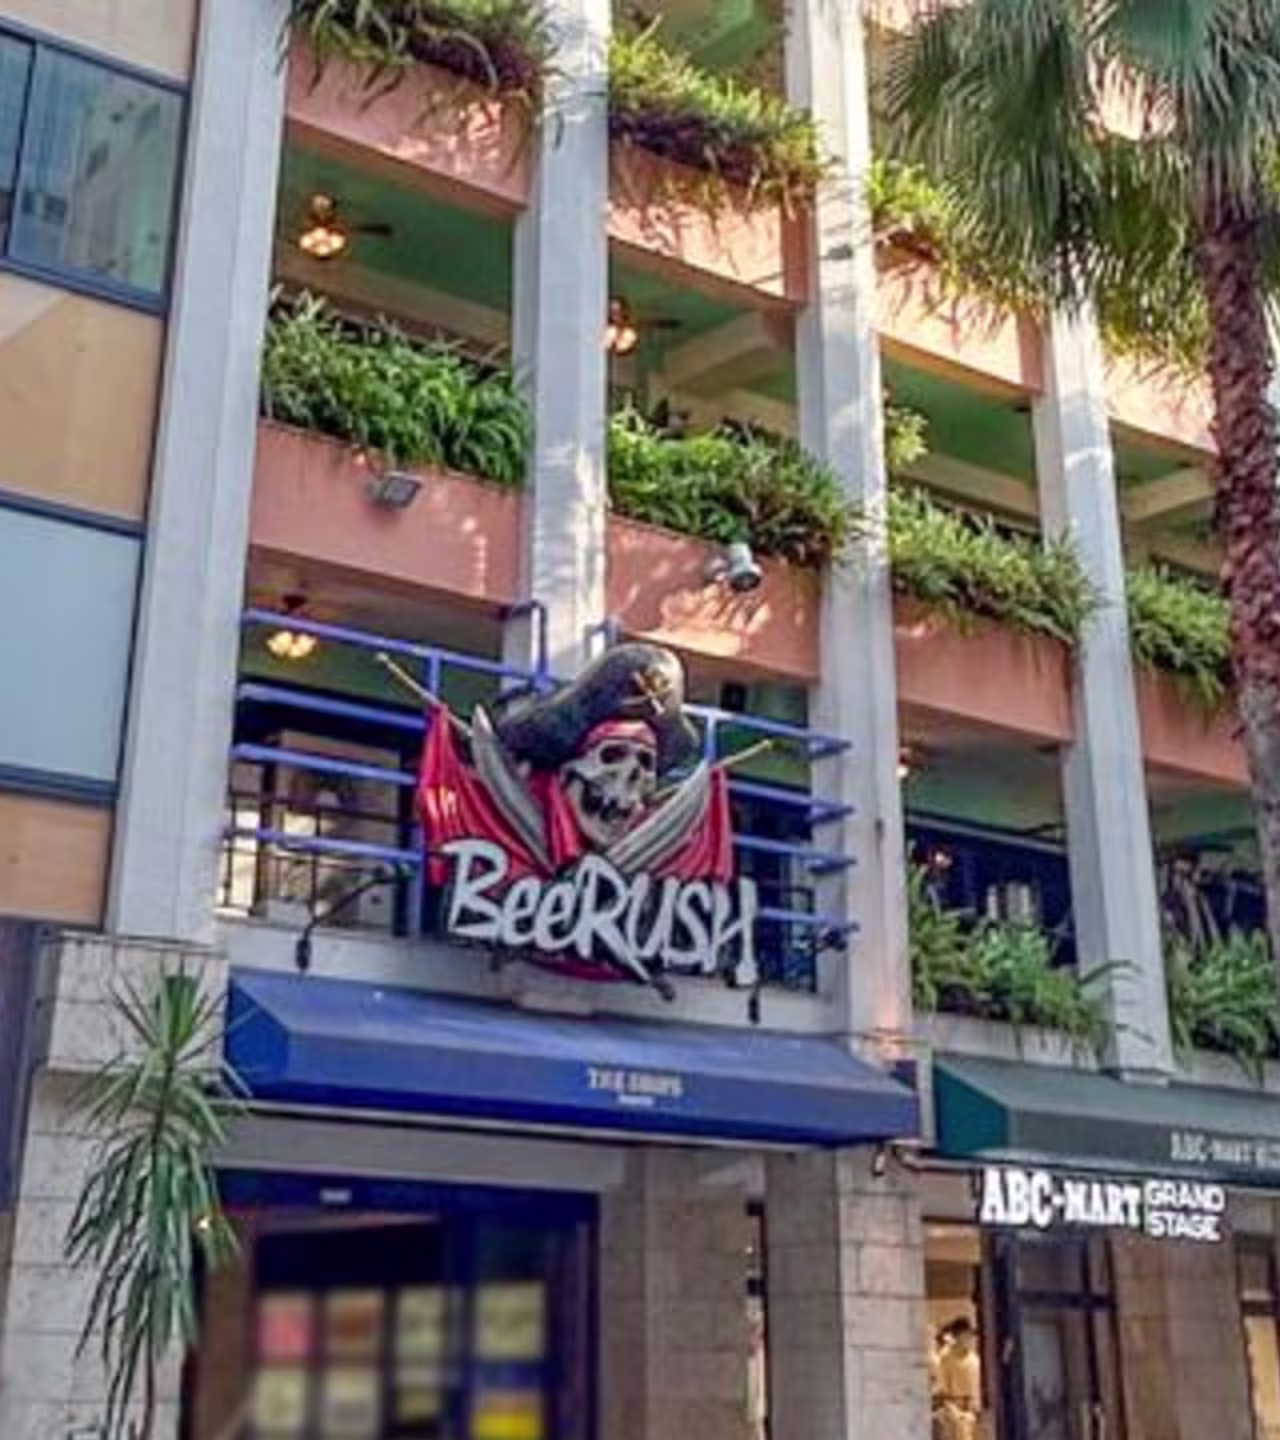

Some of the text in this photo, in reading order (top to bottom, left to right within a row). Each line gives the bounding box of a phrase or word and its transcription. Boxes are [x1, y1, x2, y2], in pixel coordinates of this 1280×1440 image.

[980, 1167, 1142, 1228] ABC-MART
[1145, 1179, 1225, 1212] GRAND
[1149, 1211, 1222, 1241] STAGE
